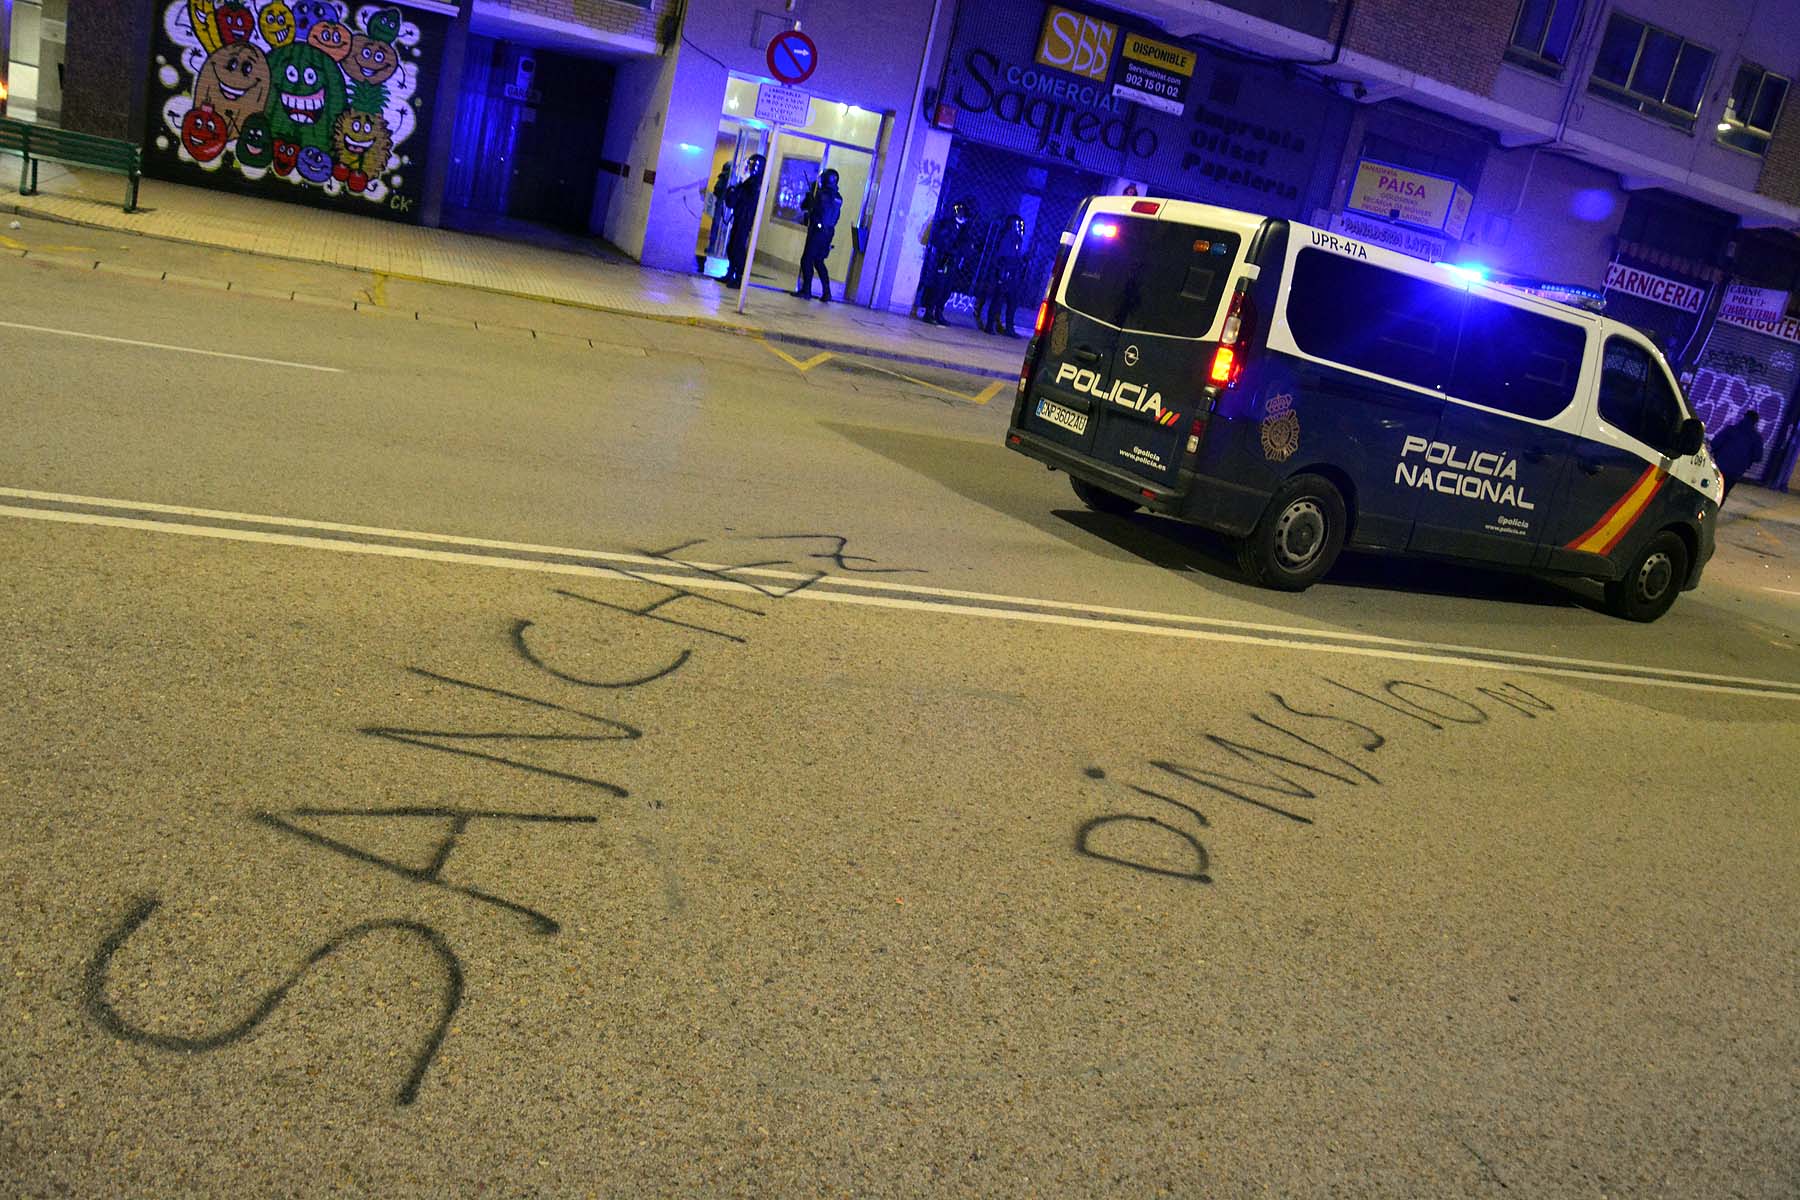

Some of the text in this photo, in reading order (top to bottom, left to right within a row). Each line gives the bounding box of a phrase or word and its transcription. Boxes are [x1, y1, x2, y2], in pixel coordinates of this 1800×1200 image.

[1132, 41, 1187, 67] DISPONIBLE
[953, 48, 1158, 159] Sagredo
[1007, 66, 1121, 112] COMERCIAL
[1126, 72, 1179, 97] 902 15 01 02
[1378, 176, 1426, 199] PAISA
[1311, 230, 1368, 260] UPR-47A
[1604, 264, 1701, 311] CARNICERIA
[1055, 363, 1163, 416] POLICÍA
[1041, 400, 1087, 432] CNP3602AU
[1401, 434, 1518, 481] POLICÍA
[1394, 462, 1535, 511] NACIONAL
